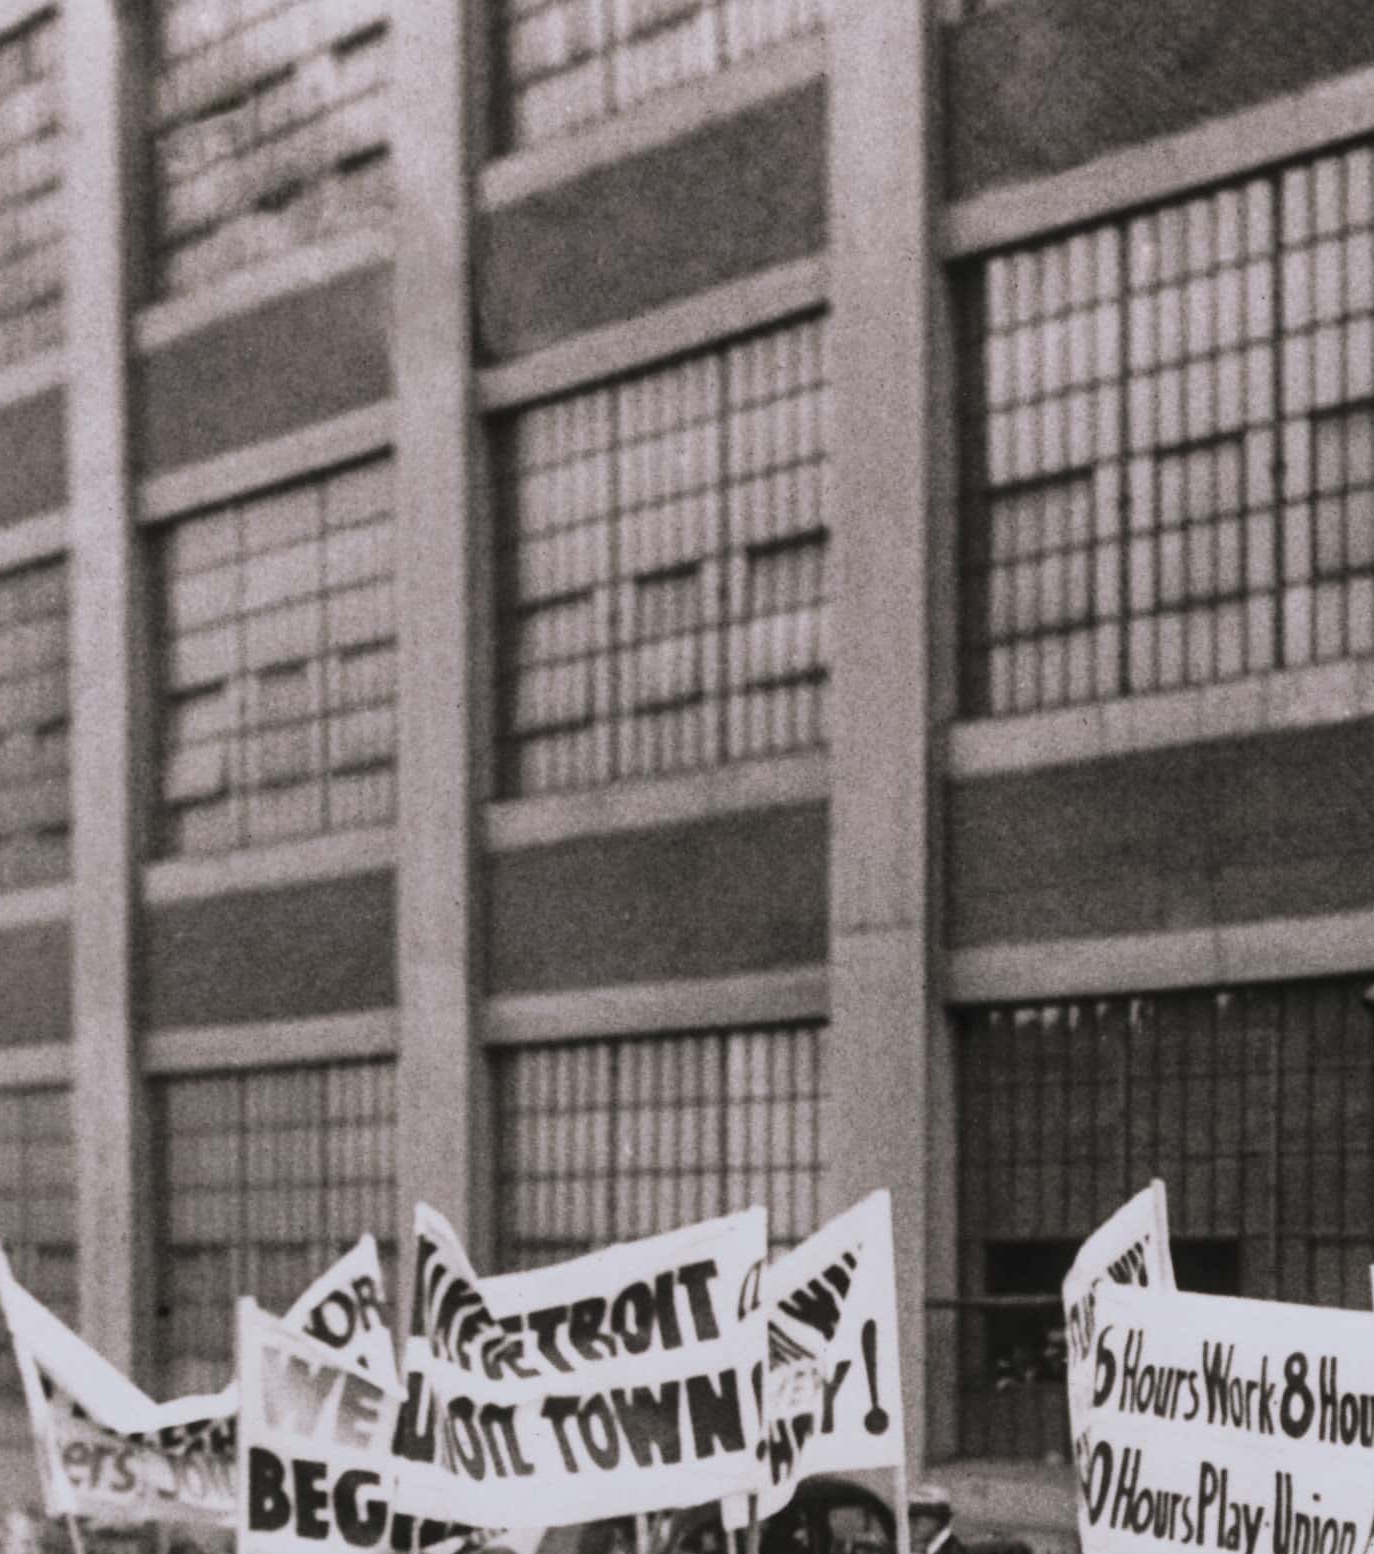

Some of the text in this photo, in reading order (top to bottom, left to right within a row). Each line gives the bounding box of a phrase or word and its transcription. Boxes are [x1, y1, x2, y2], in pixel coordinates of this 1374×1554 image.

[392, 1371, 535, 1482] UON
[1119, 1328, 1199, 1421] Hours
[1280, 1352, 1315, 1440] 8
[1109, 1446, 1195, 1546] Hours
